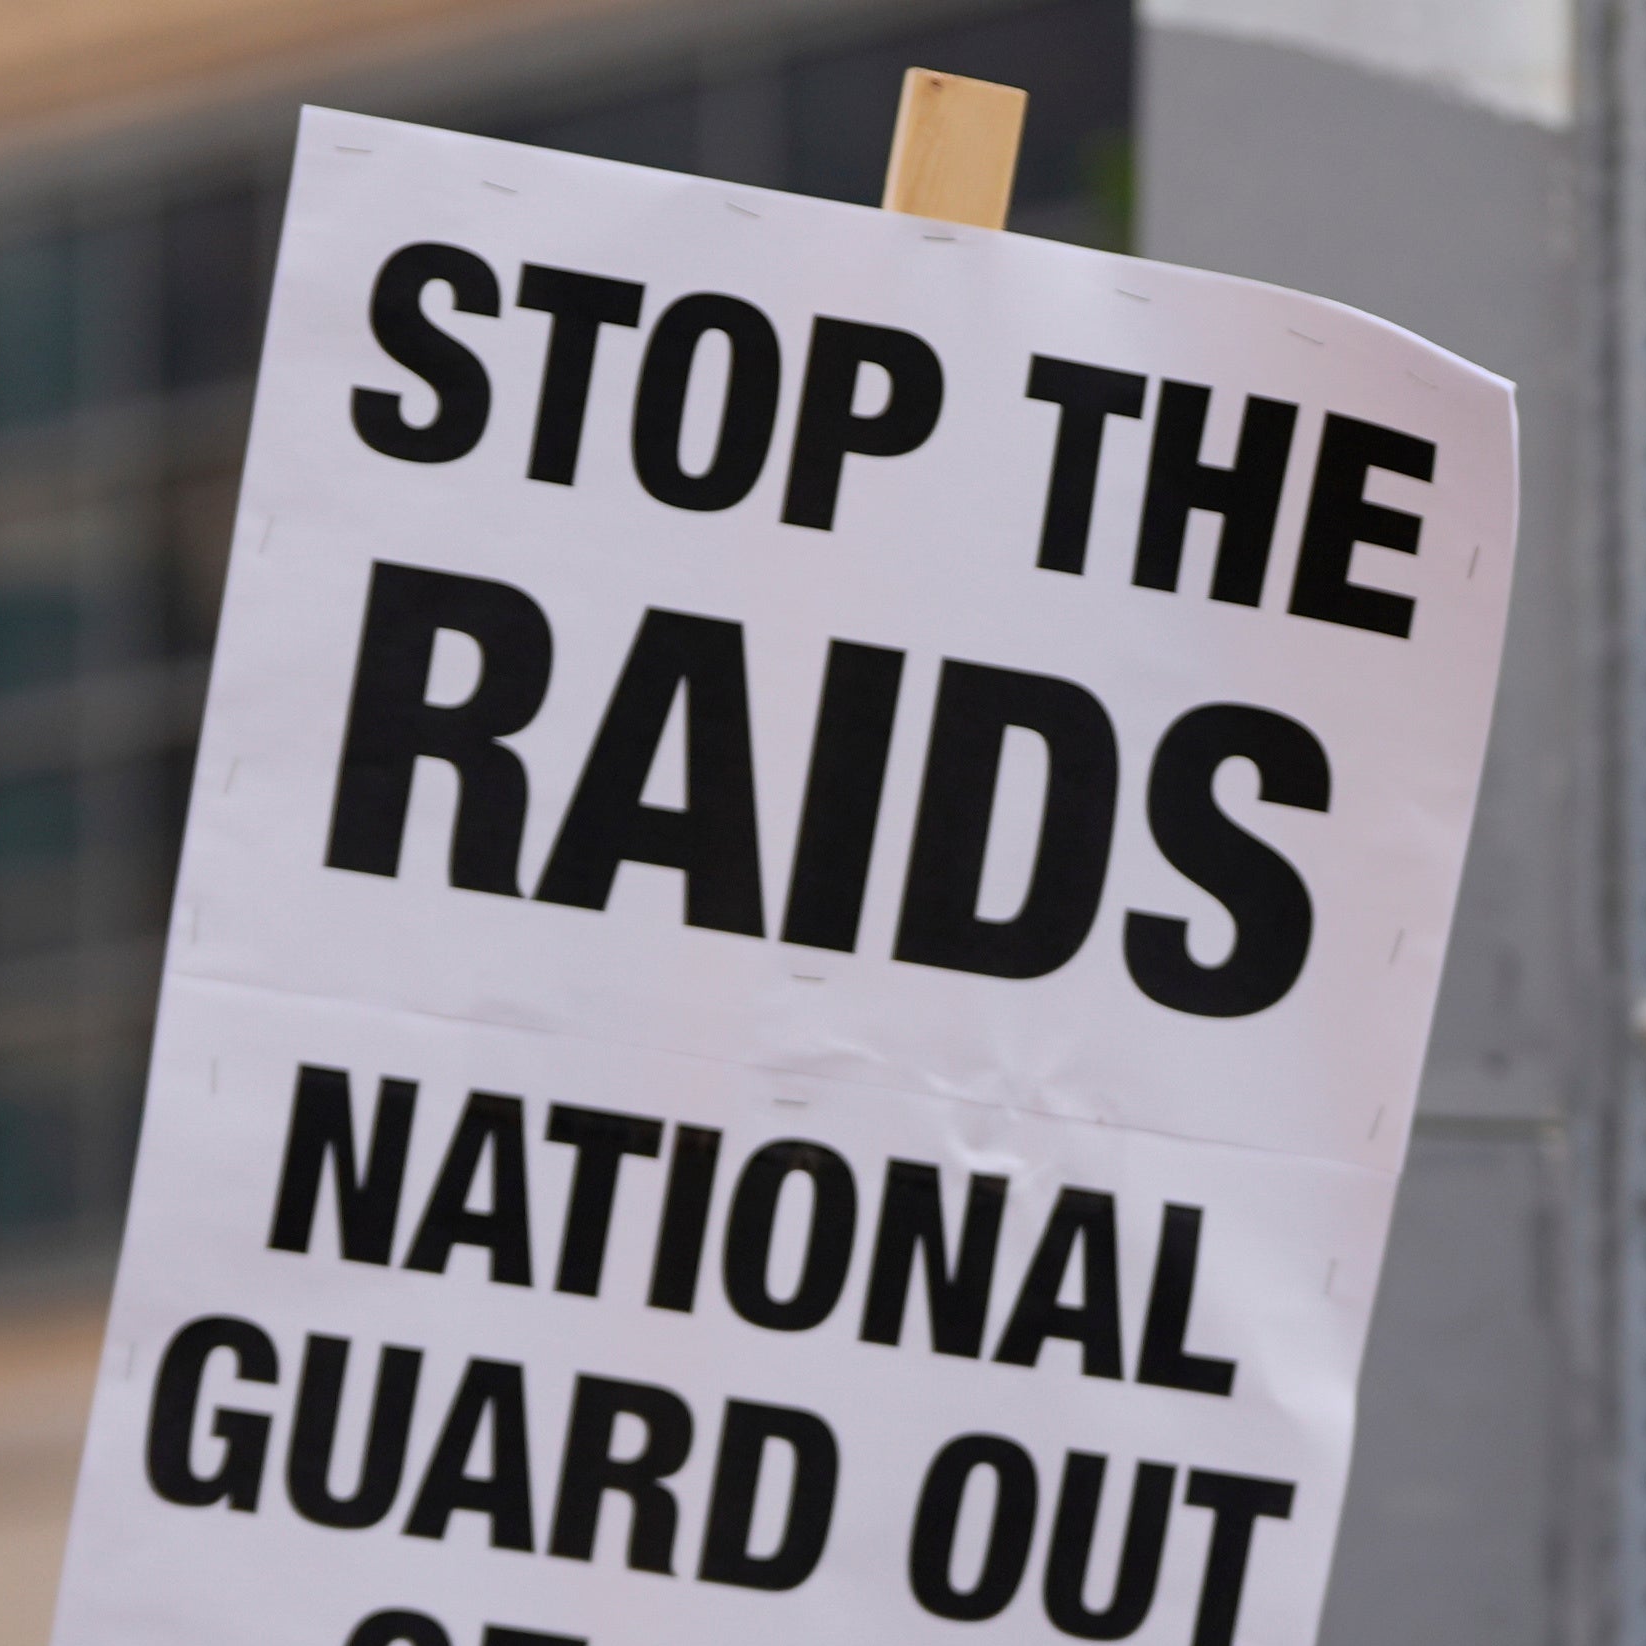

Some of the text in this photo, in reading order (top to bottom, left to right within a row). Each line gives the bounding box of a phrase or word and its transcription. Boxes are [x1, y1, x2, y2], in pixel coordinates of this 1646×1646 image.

[350, 242, 1438, 640] STOP THE
[324, 560, 1332, 1019] RAIDS
[266, 1063, 1237, 1398] NATIONAL
[145, 1315, 840, 1593] GUARD
